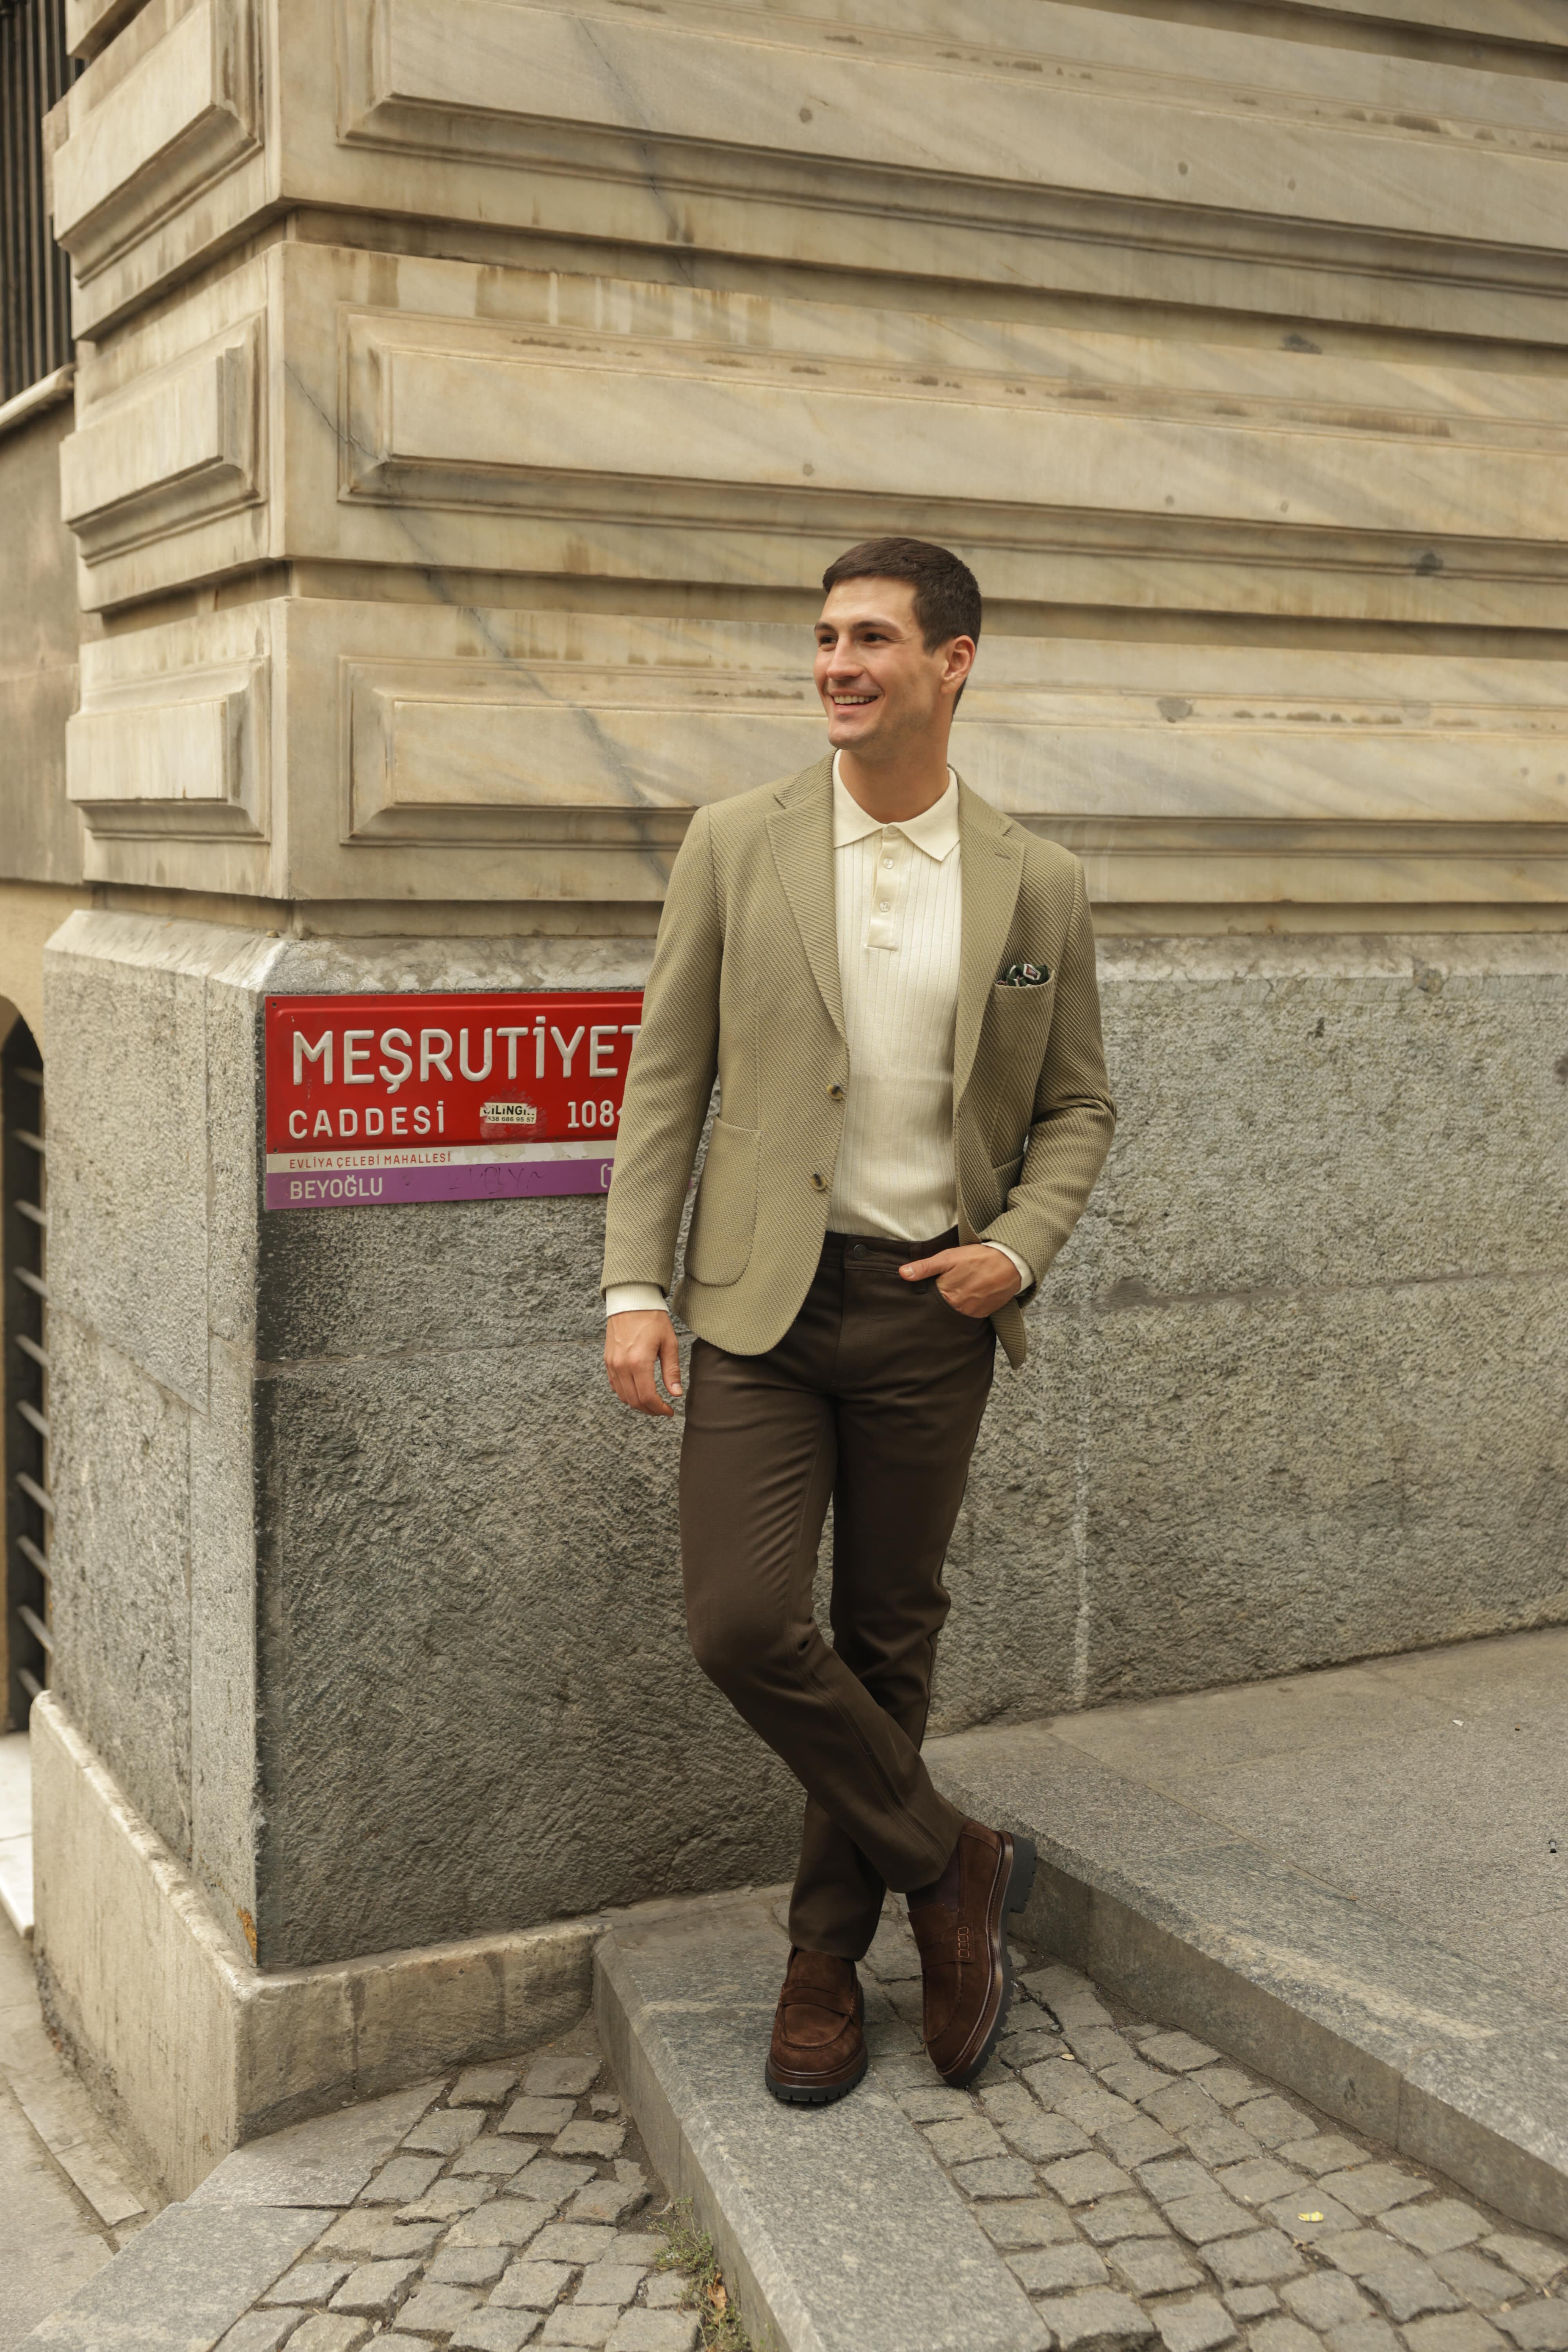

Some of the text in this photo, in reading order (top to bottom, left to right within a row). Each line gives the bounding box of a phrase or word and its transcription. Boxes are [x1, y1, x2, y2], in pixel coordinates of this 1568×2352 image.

[289, 1100, 444, 1140] CADDESİ
[568, 1099, 623, 1128] 108
[290, 1151, 450, 1169] EVLİYA ÇELEBİ MAHALLESİ
[290, 1175, 382, 1200] BEYOĞLU
